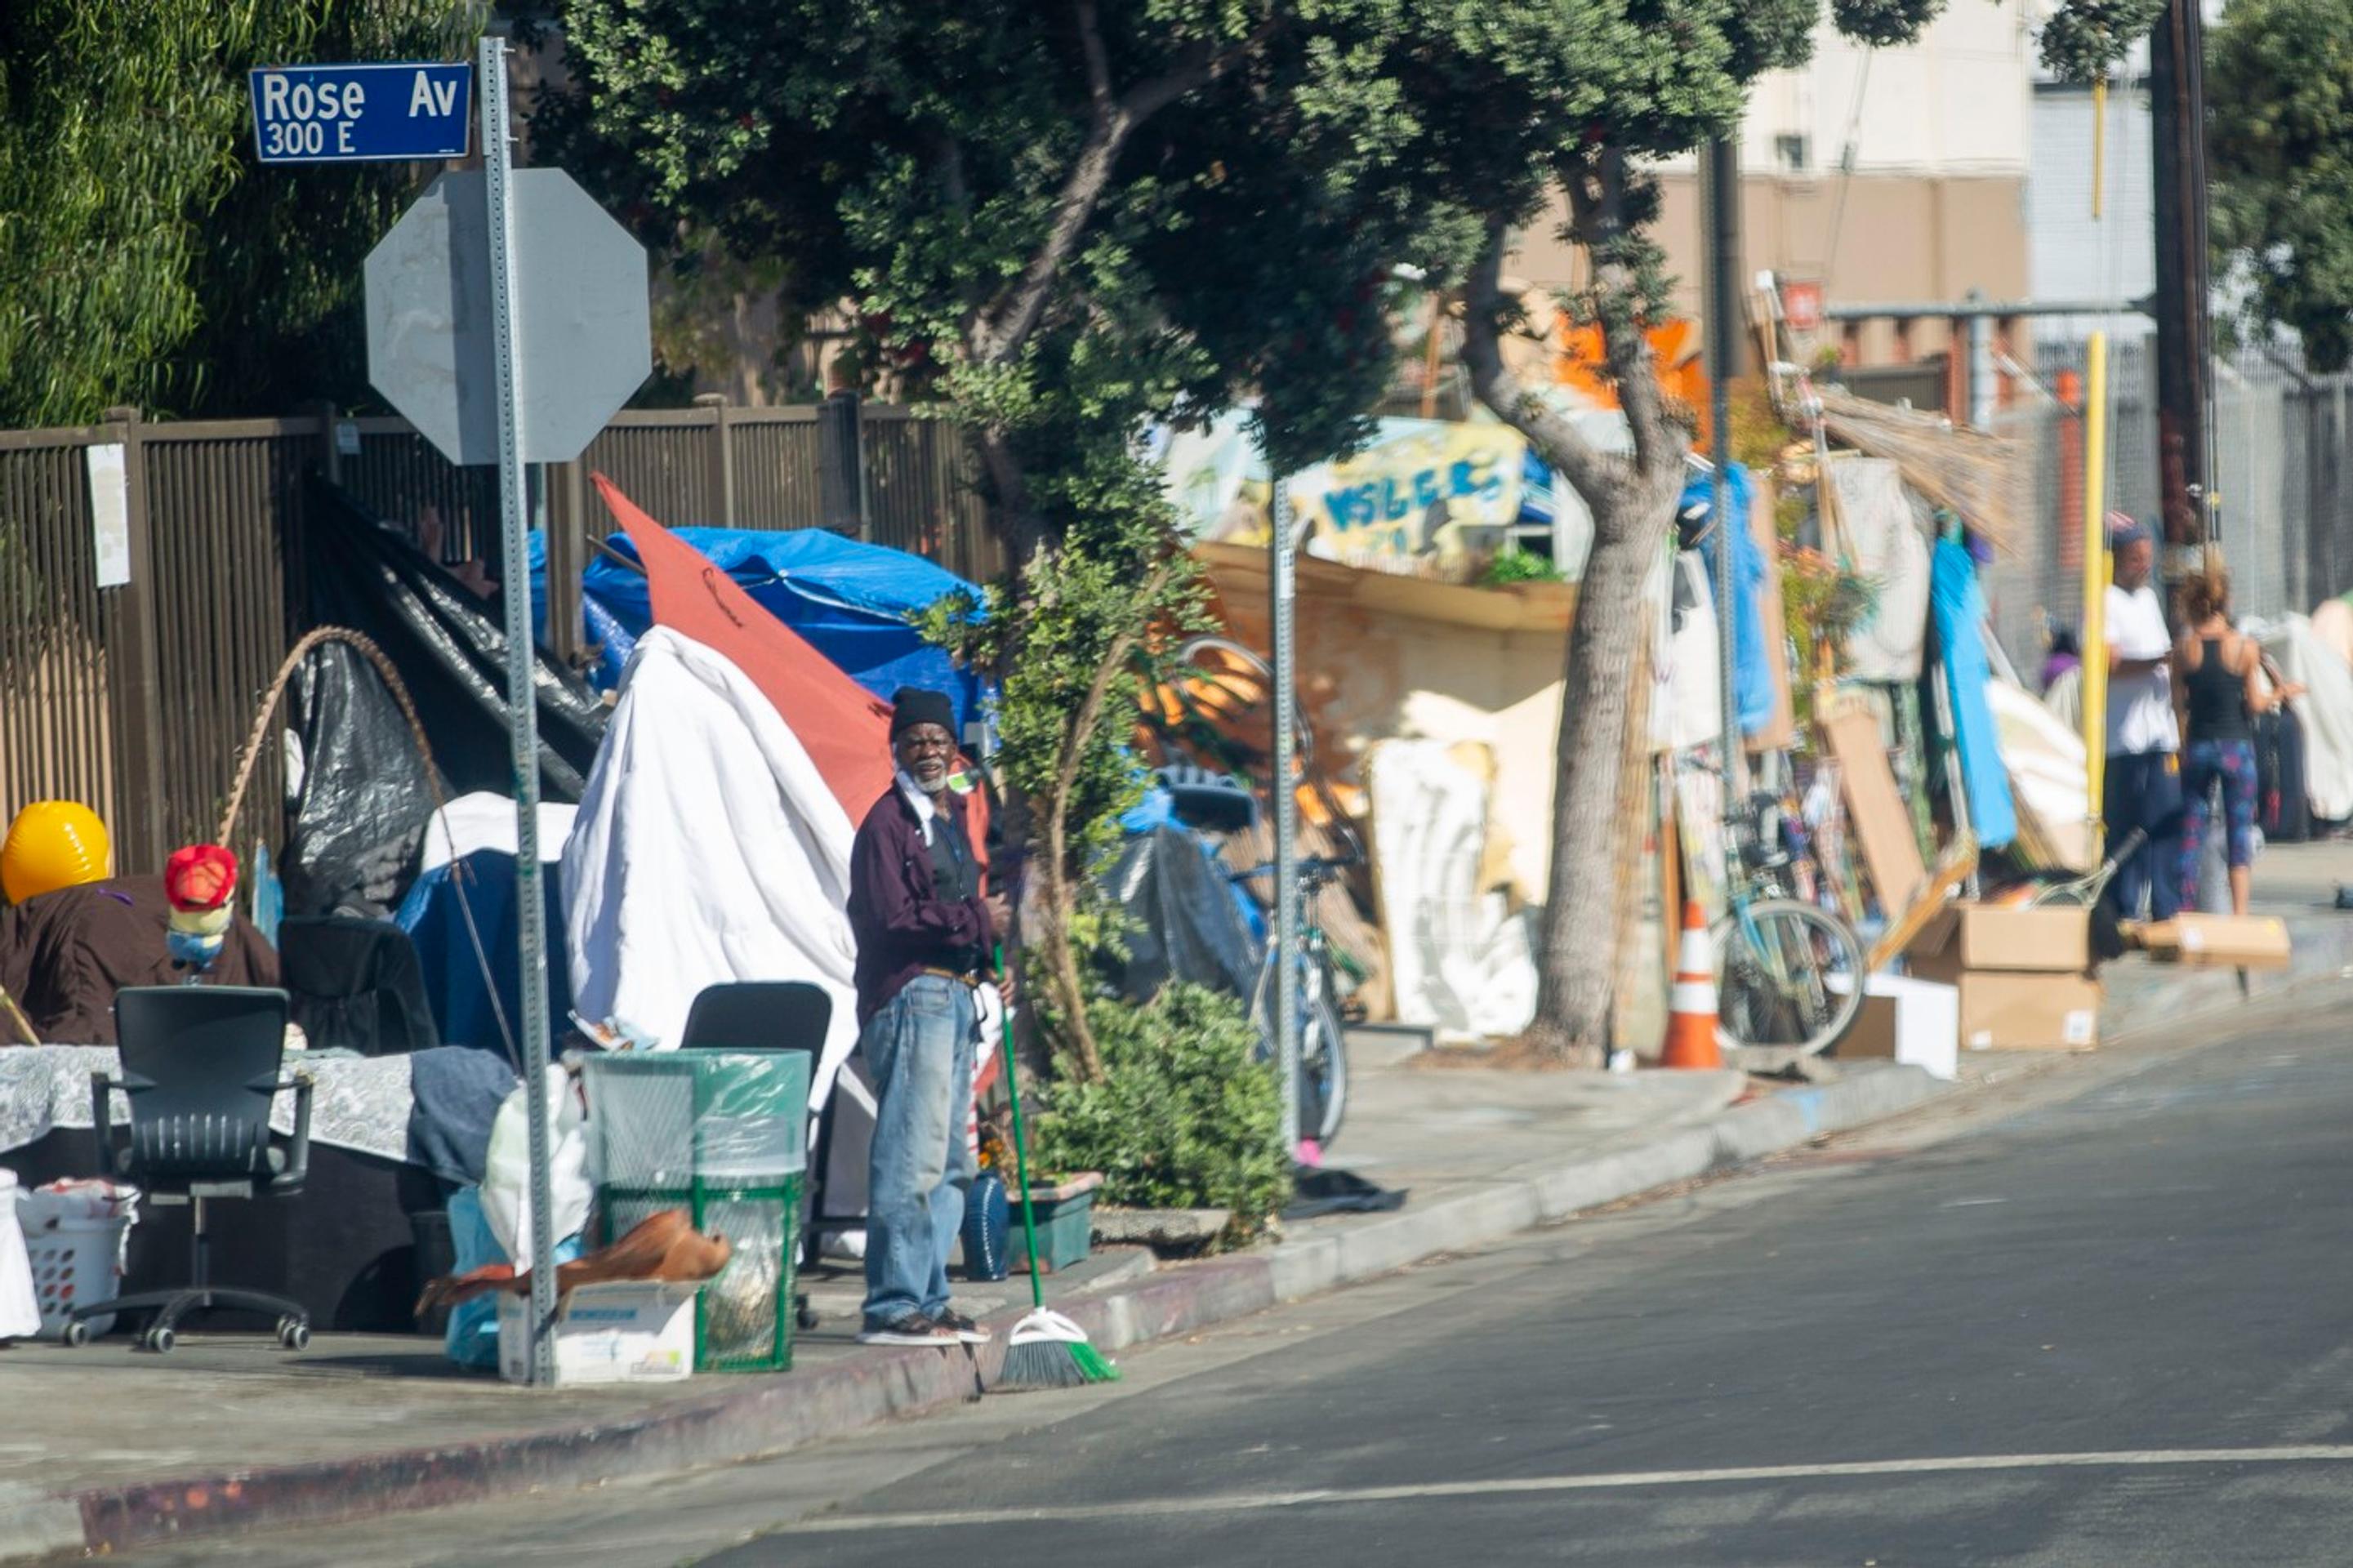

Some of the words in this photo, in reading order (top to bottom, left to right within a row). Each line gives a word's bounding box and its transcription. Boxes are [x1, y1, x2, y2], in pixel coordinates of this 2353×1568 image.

[263, 74, 365, 121] Rose
[408, 70, 457, 118] Av
[266, 122, 323, 155] 300
[337, 121, 356, 154] E
